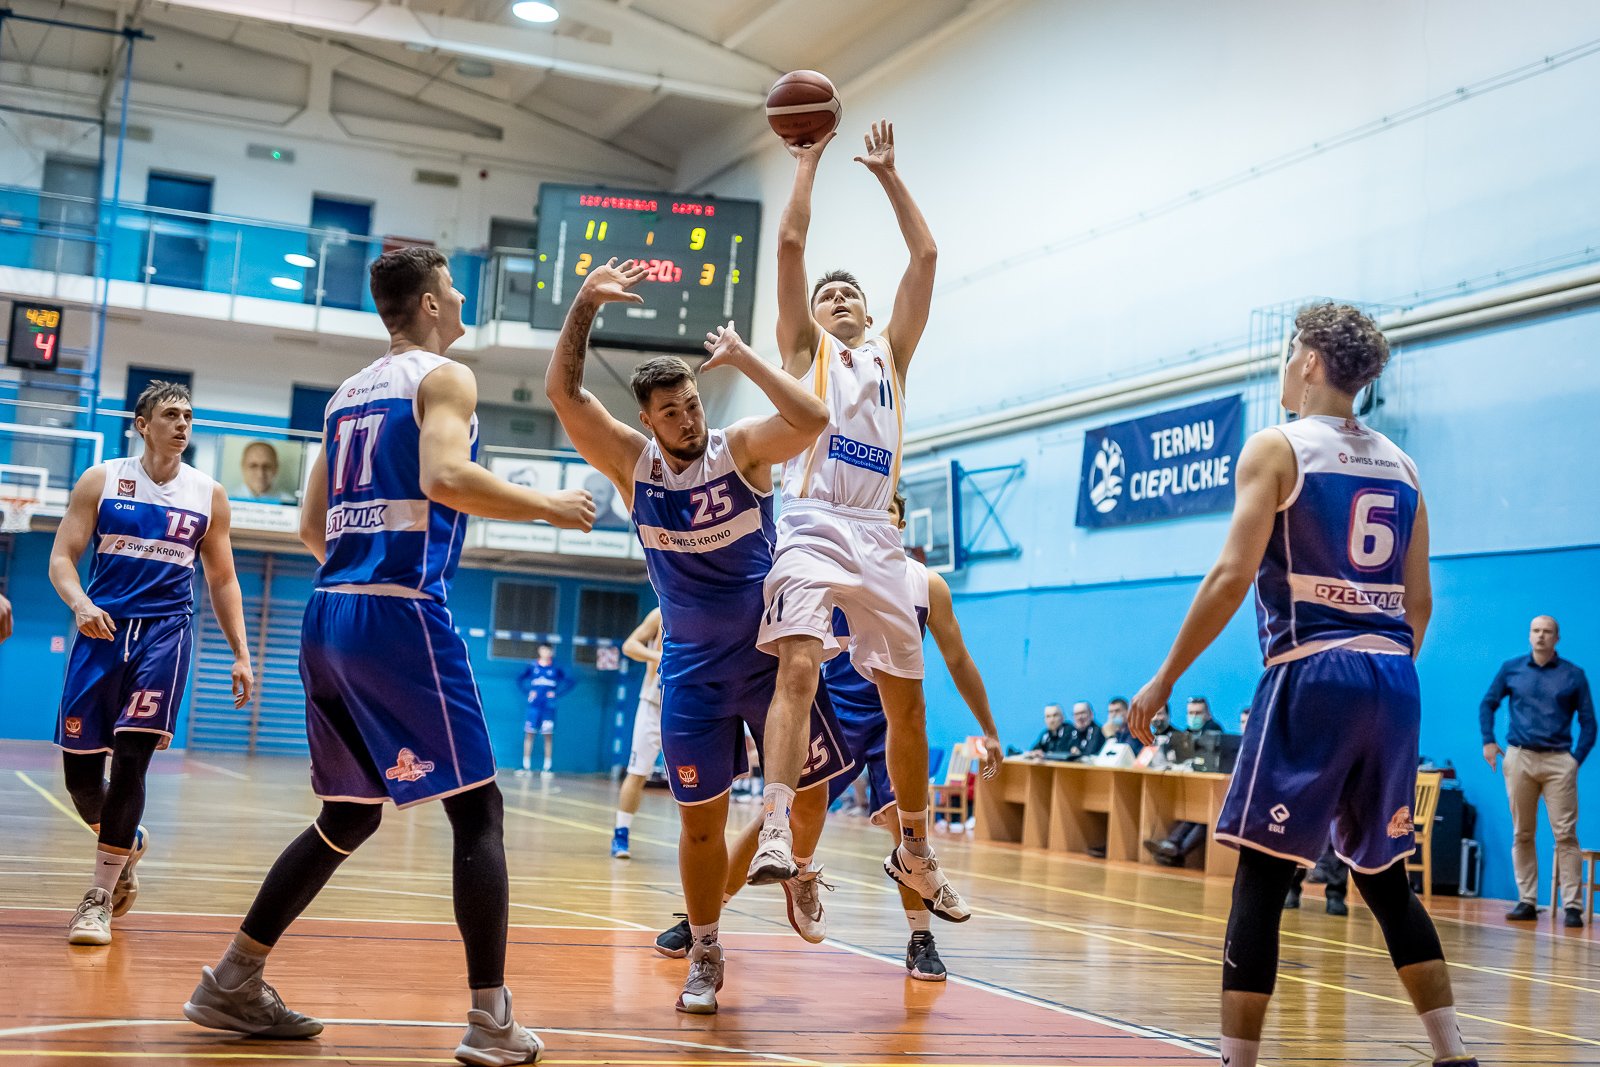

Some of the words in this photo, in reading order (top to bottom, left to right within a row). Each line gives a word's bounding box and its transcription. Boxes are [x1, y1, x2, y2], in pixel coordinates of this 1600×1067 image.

[585, 220, 608, 241] 11
[689, 227, 707, 251] 9
[575, 253, 593, 276] 2
[699, 263, 716, 286] 3
[35, 332, 56, 361] 4
[879, 379, 893, 410] 11
[334, 409, 388, 495] 17
[1151, 419, 1214, 460] TERMY
[1350, 455, 1373, 466] SWISS
[1130, 455, 1231, 501] CIEPLICKIE
[123, 503, 135, 511] EGLE
[691, 480, 733, 527] 25
[166, 510, 200, 541] 15
[670, 536, 697, 547] SWISS
[697, 529, 731, 546] KRONO
[1349, 488, 1399, 571] 6
[127, 542, 155, 553] SWISS
[156, 546, 185, 559] KRONO
[126, 689, 164, 718] 15
